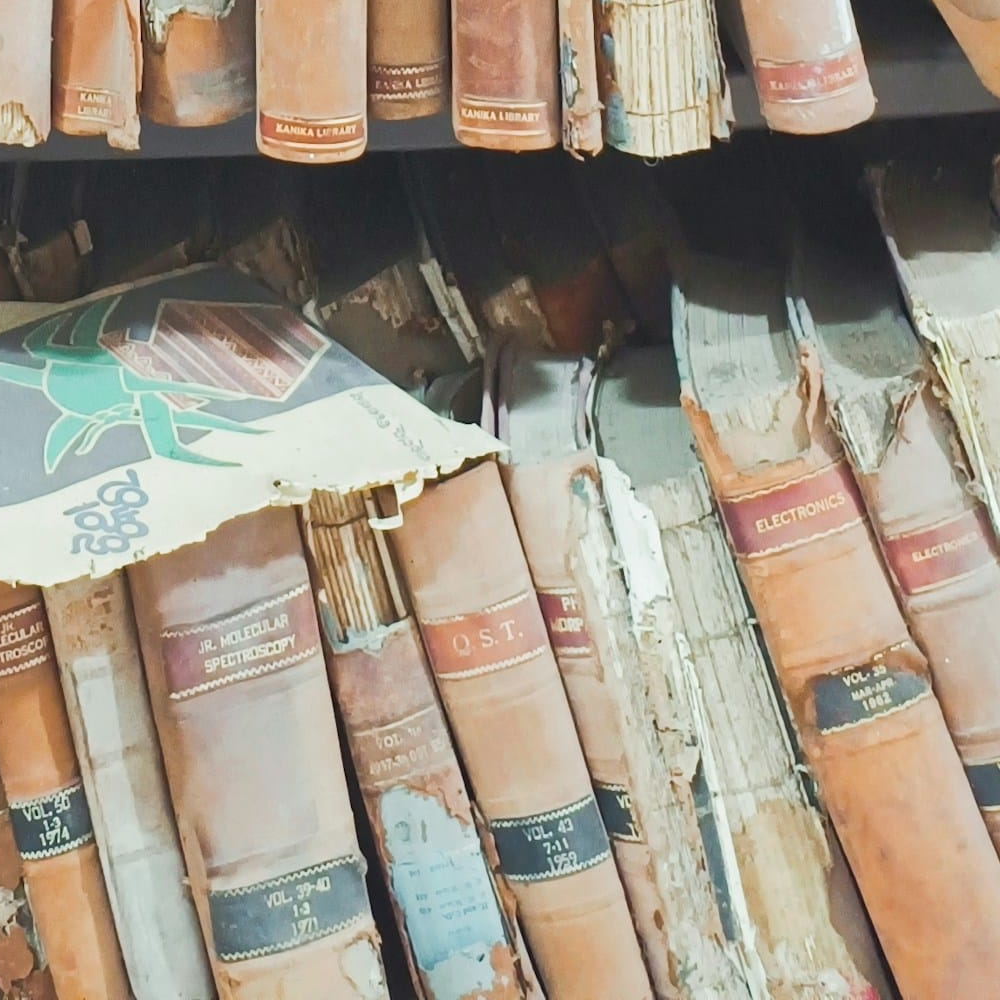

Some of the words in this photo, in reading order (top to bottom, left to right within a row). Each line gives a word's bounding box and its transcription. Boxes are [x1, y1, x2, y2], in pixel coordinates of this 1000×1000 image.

[460, 107, 497, 122] KANIKA
[275, 122, 315, 137] KANIKA
[755, 491, 847, 535] ELECTRONICS
[911, 530, 979, 563] ELECTRONICS
[198, 638, 218, 655] JR.
[219, 613, 290, 649] MOLECULAR
[203, 633, 297, 674] SPECTROSCOPY
[21, 802, 53, 822] VOL.
[42, 816, 62, 832] 1-3
[522, 825, 554, 842] VOL.
[557, 817, 575, 834] 43
[38, 825, 71, 847] 1974
[264, 890, 294, 909] VOL.
[295, 875, 332, 899] 39-40
[292, 901, 311, 919] 1-3
[291, 916, 319, 937] 1971
